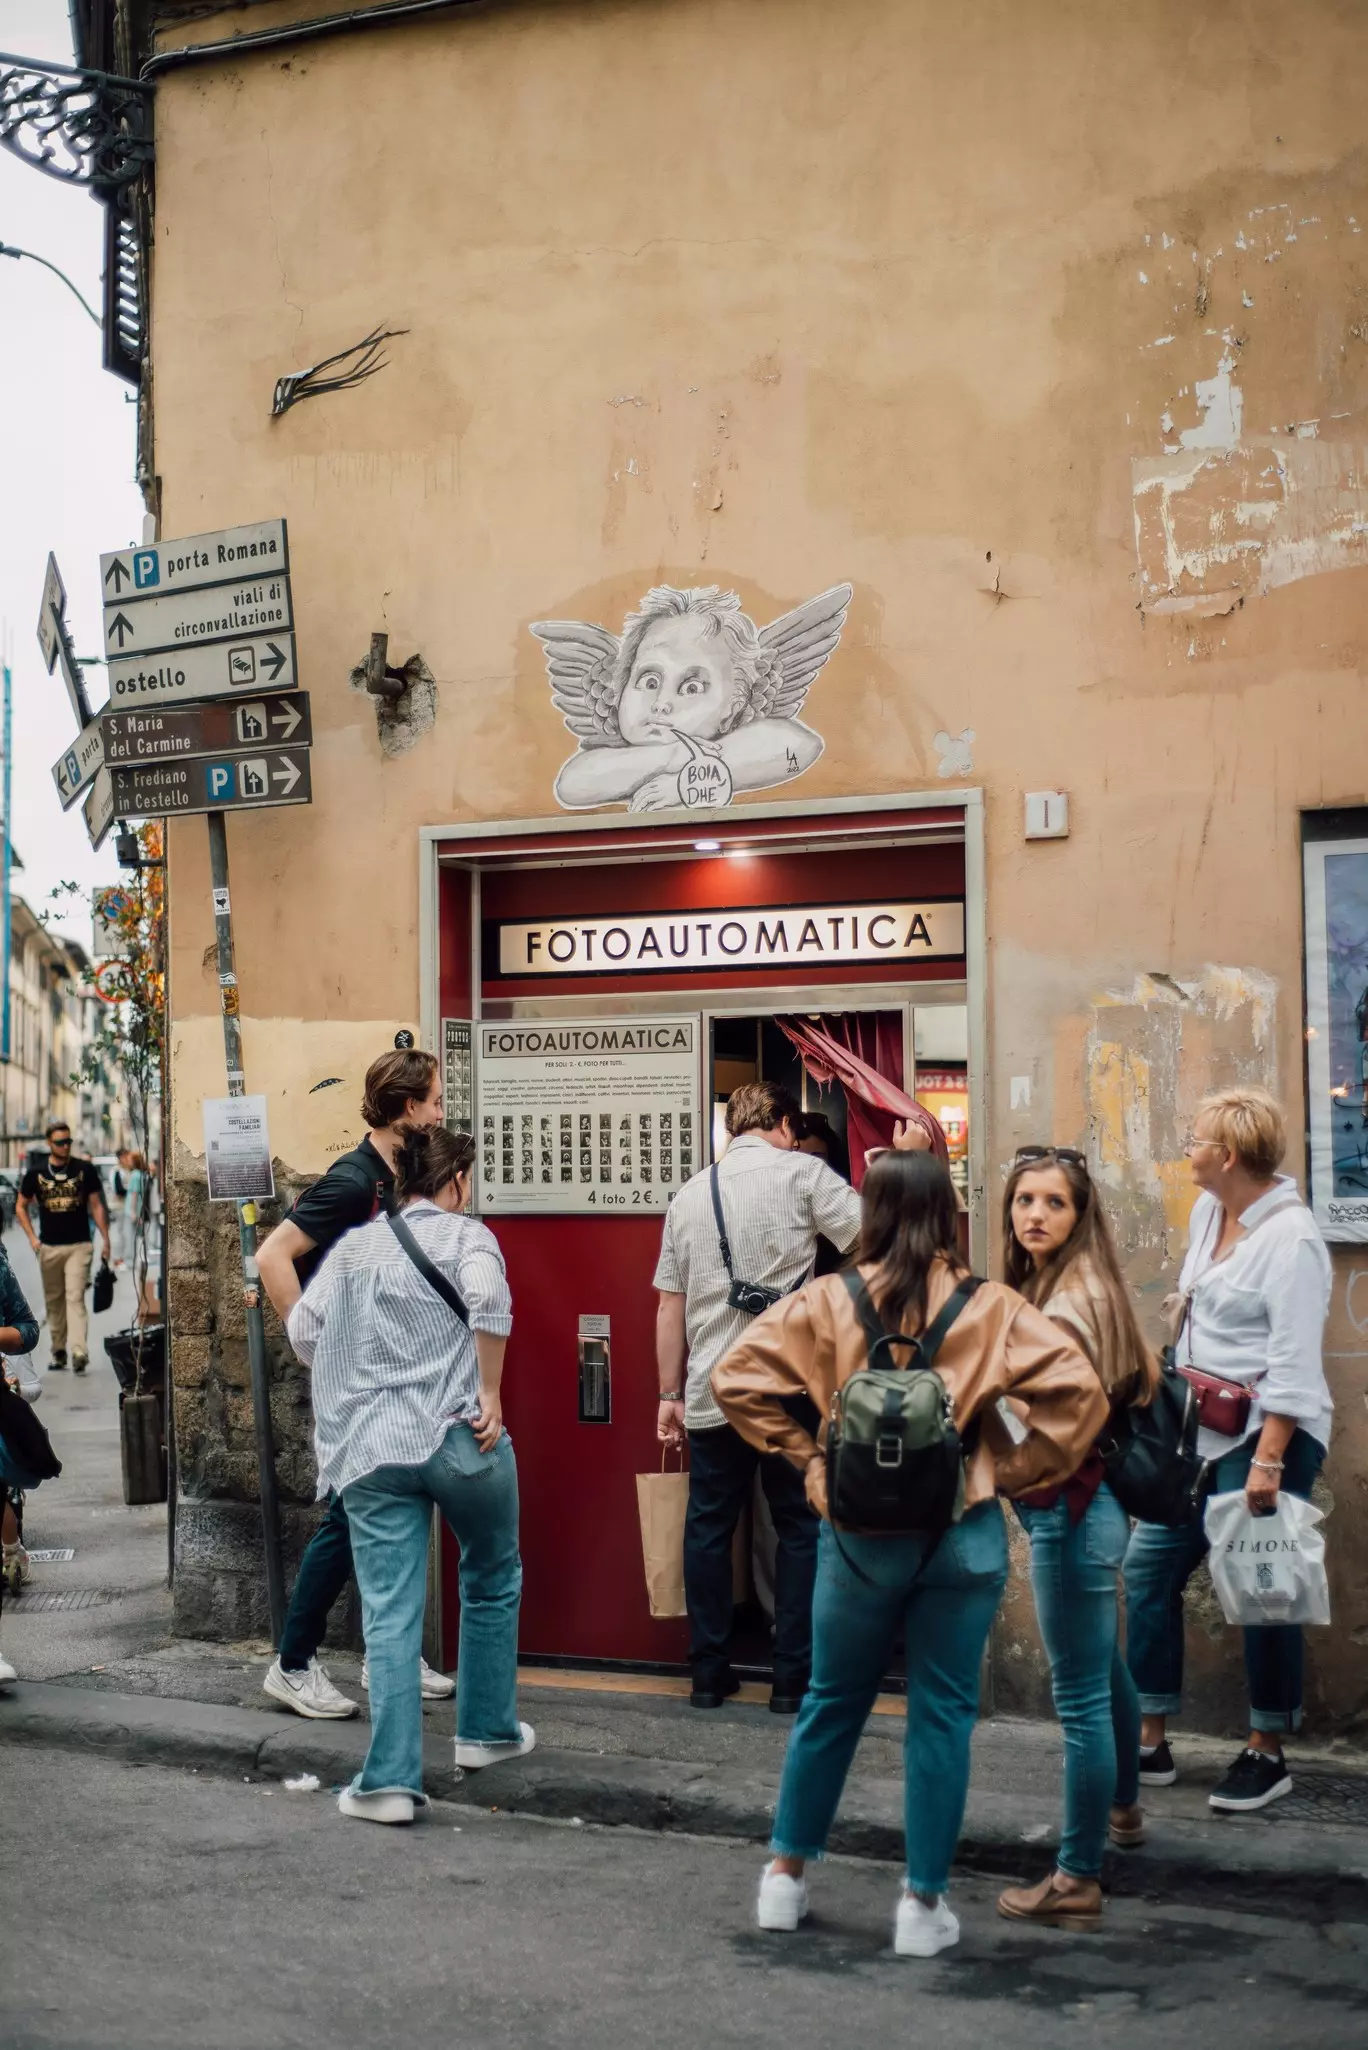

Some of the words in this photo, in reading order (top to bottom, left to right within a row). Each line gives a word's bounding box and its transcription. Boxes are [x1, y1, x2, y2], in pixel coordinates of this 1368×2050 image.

[168, 550, 209, 577] porta
[218, 538, 277, 563] Romana
[233, 587, 264, 606] viali
[269, 583, 281, 601] di
[174, 609, 282, 638] circonvallazione
[115, 668, 186, 695] ostello
[109, 719, 123, 735] S.
[127, 715, 164, 732] Maria
[81, 737, 100, 766] porta
[110, 737, 131, 757] del
[137, 735, 191, 753] Carmine
[118, 774, 130, 789] S.
[134, 770, 187, 787] Frediano
[119, 794, 130, 812] in
[135, 791, 188, 809] Cestello
[587, 1190, 597, 1204] 4
[602, 1193, 626, 1204] foto
[1225, 1539, 1298, 1553] SIMONE
